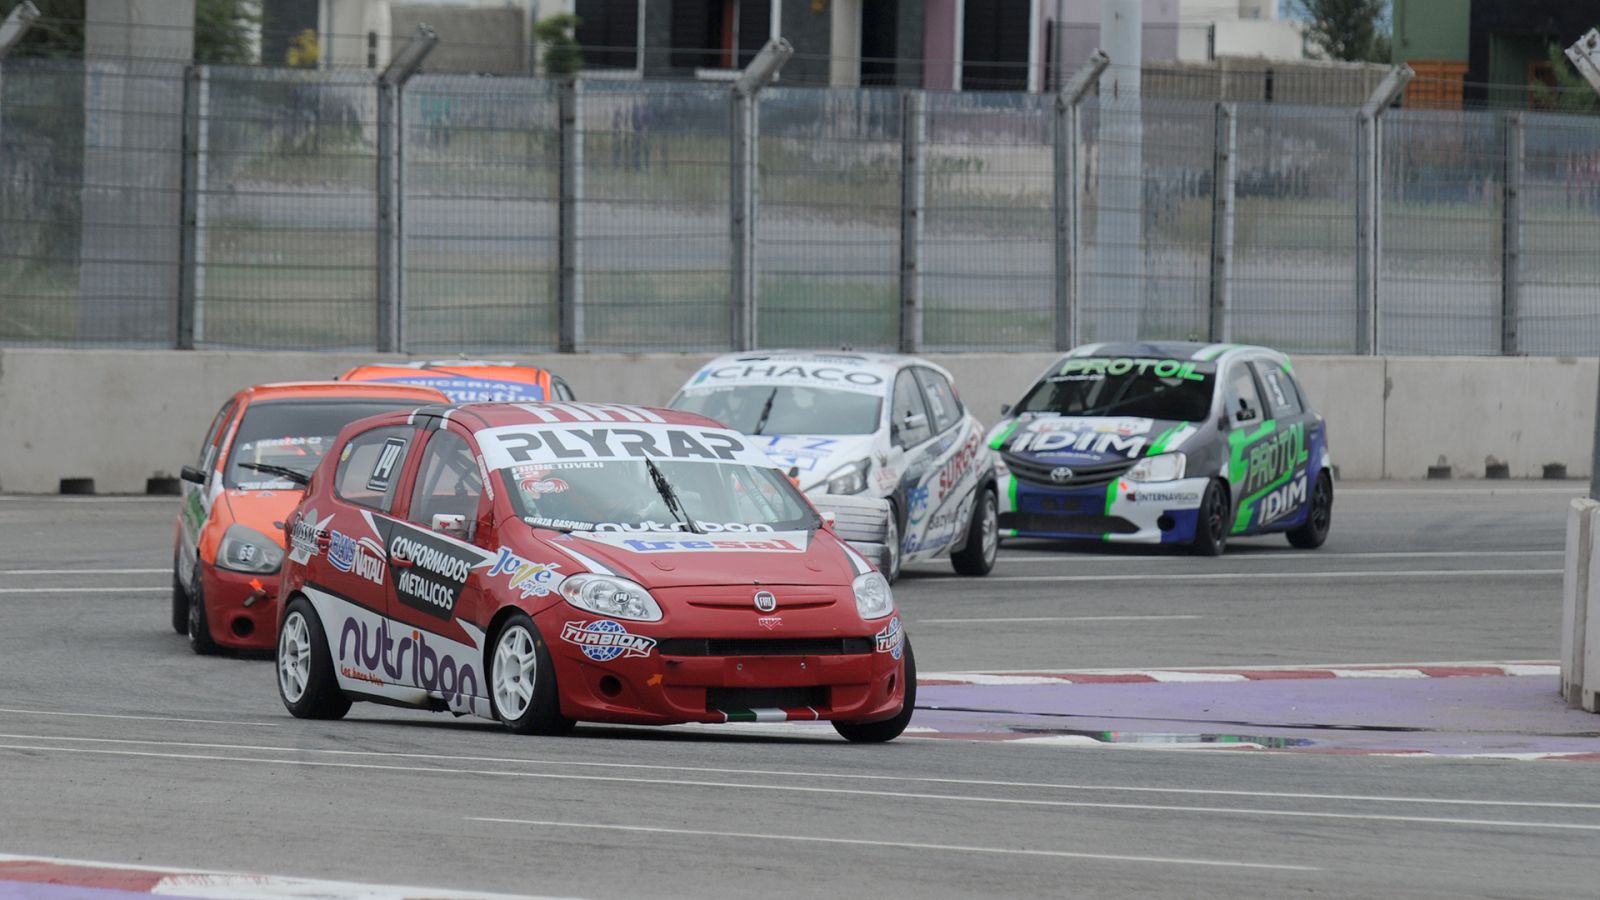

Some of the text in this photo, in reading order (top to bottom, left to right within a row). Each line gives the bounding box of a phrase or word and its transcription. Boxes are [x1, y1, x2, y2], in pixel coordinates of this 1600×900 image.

[711, 366, 883, 385] CHACO
[1060, 358, 1204, 381] PROTOIL
[373, 444, 401, 478] 14
[497, 428, 745, 462] PLYRAP
[1009, 430, 1148, 459] IDIM
[1258, 475, 1308, 527] IDIM
[595, 520, 774, 534] nutribon
[330, 530, 357, 563] TRANS
[351, 544, 386, 586] NATALI
[390, 536, 471, 584] CONFORMADOS
[624, 539, 799, 552] tresal
[398, 570, 454, 611] METALICOS
[565, 627, 651, 651] TURBION
[339, 614, 478, 718] nutribon
